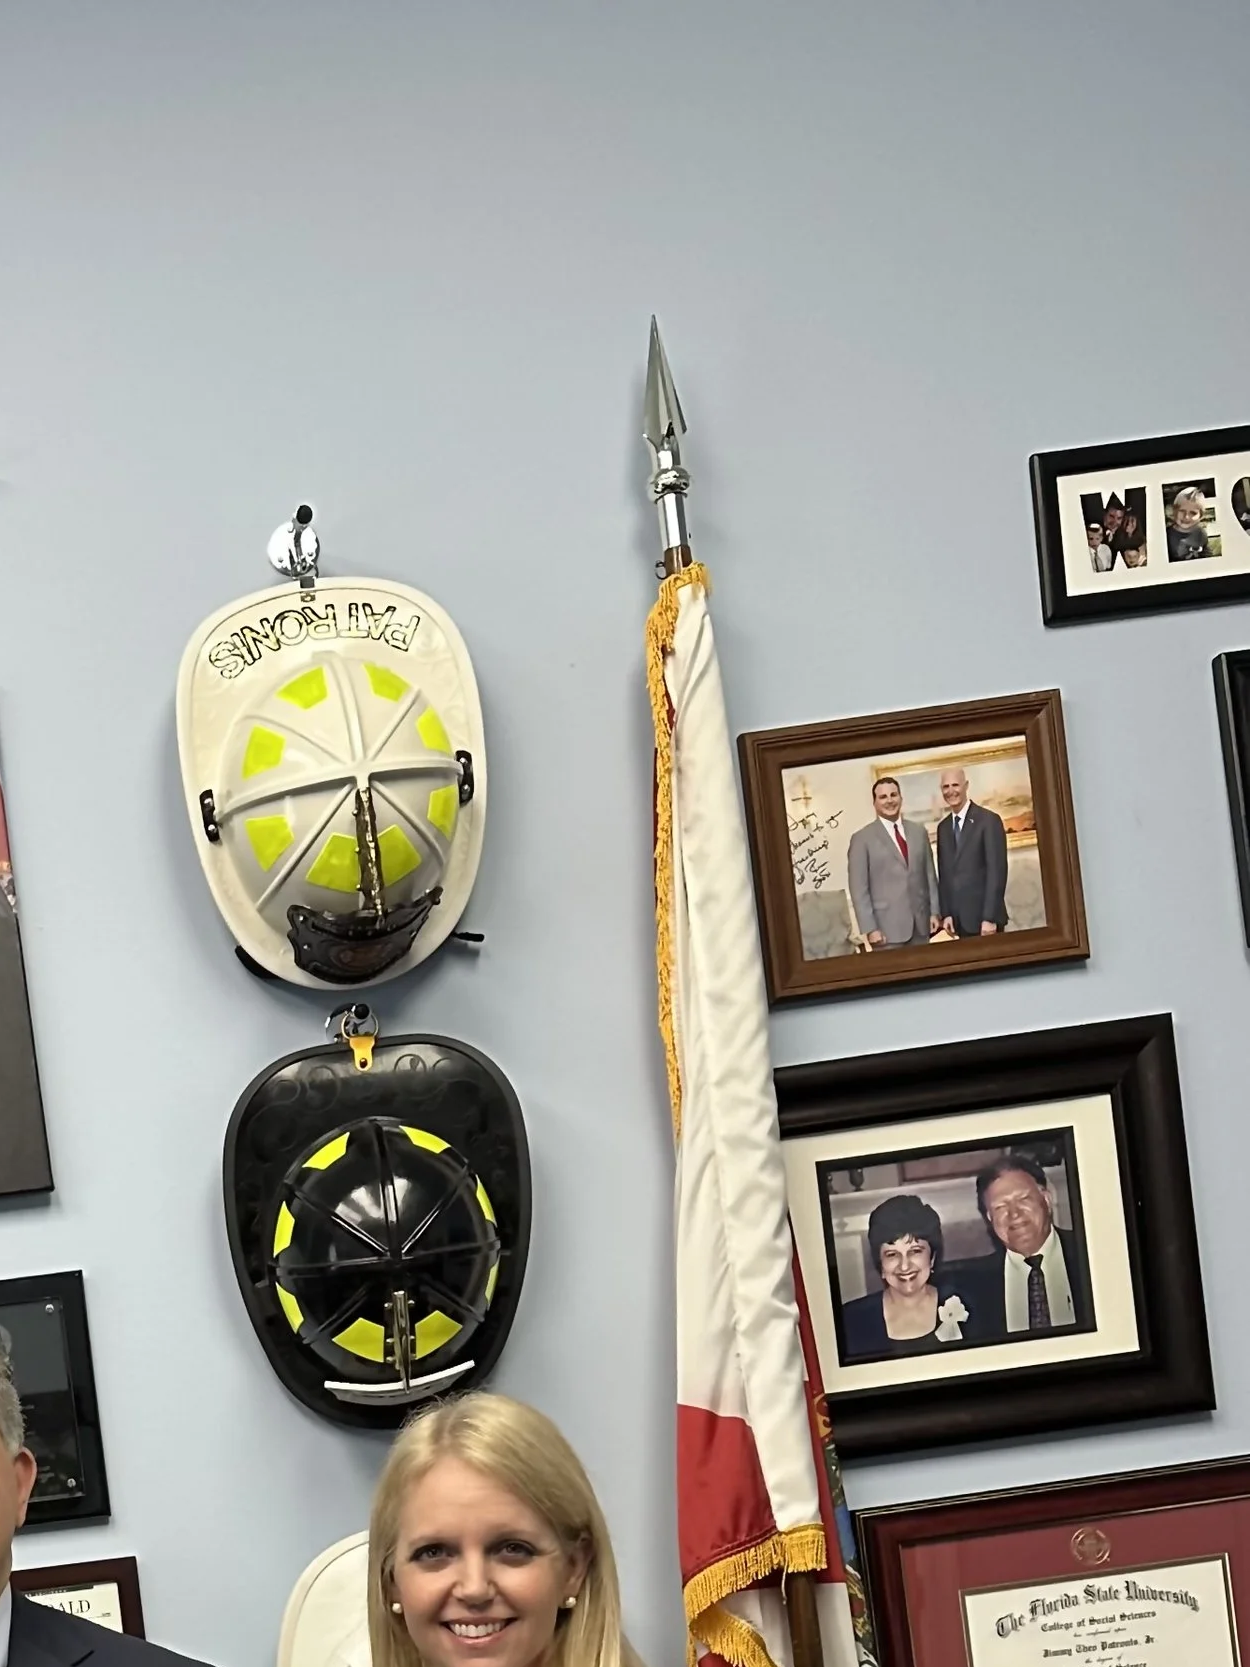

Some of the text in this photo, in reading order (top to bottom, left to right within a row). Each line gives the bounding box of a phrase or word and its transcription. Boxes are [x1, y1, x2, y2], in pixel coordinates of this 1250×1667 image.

[209, 602, 420, 680] PATRONIS
[995, 1579, 1200, 1639] The Florida State University
